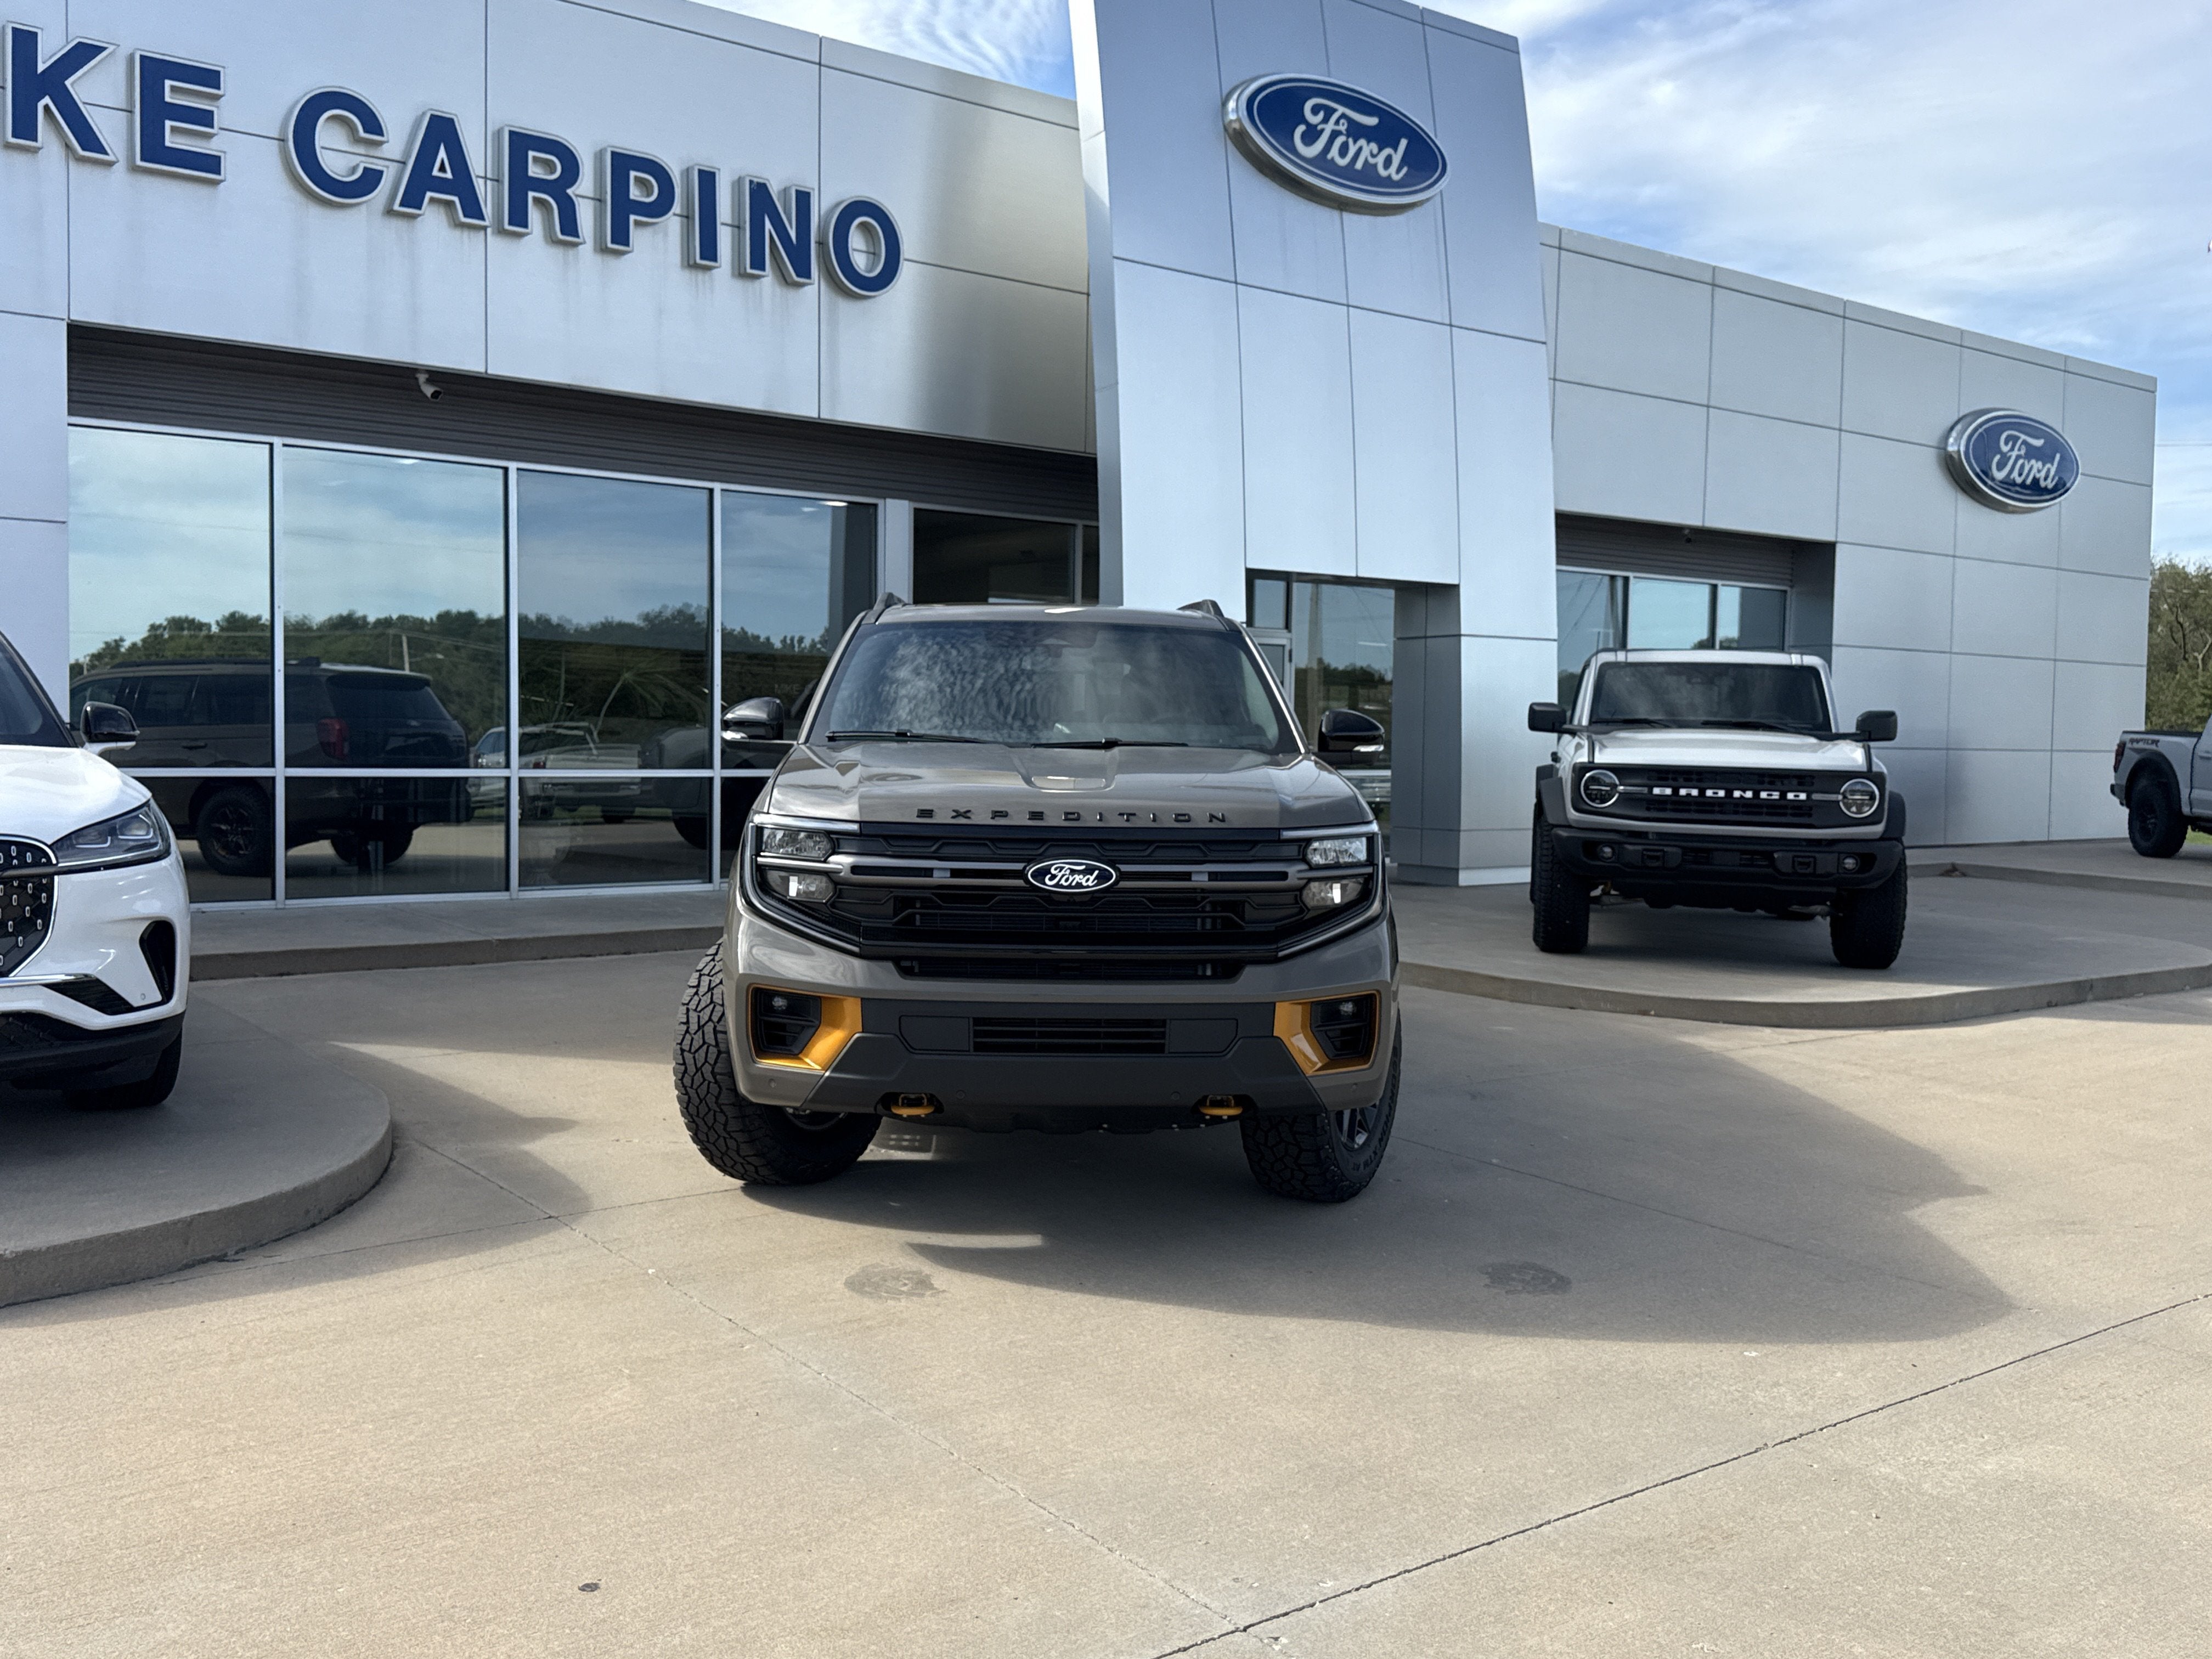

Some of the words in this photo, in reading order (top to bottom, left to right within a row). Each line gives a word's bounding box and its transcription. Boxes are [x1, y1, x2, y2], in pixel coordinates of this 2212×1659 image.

[1293, 97, 1408, 181] Ford
[285, 86, 904, 297] CARPINO
[1991, 430, 2060, 489] Ford
[2129, 738, 2160, 748] RAPTOR
[1652, 787, 1807, 800] BRONCO
[916, 808, 1226, 823] EXPEDITION
[1045, 864, 1099, 887] Ford
